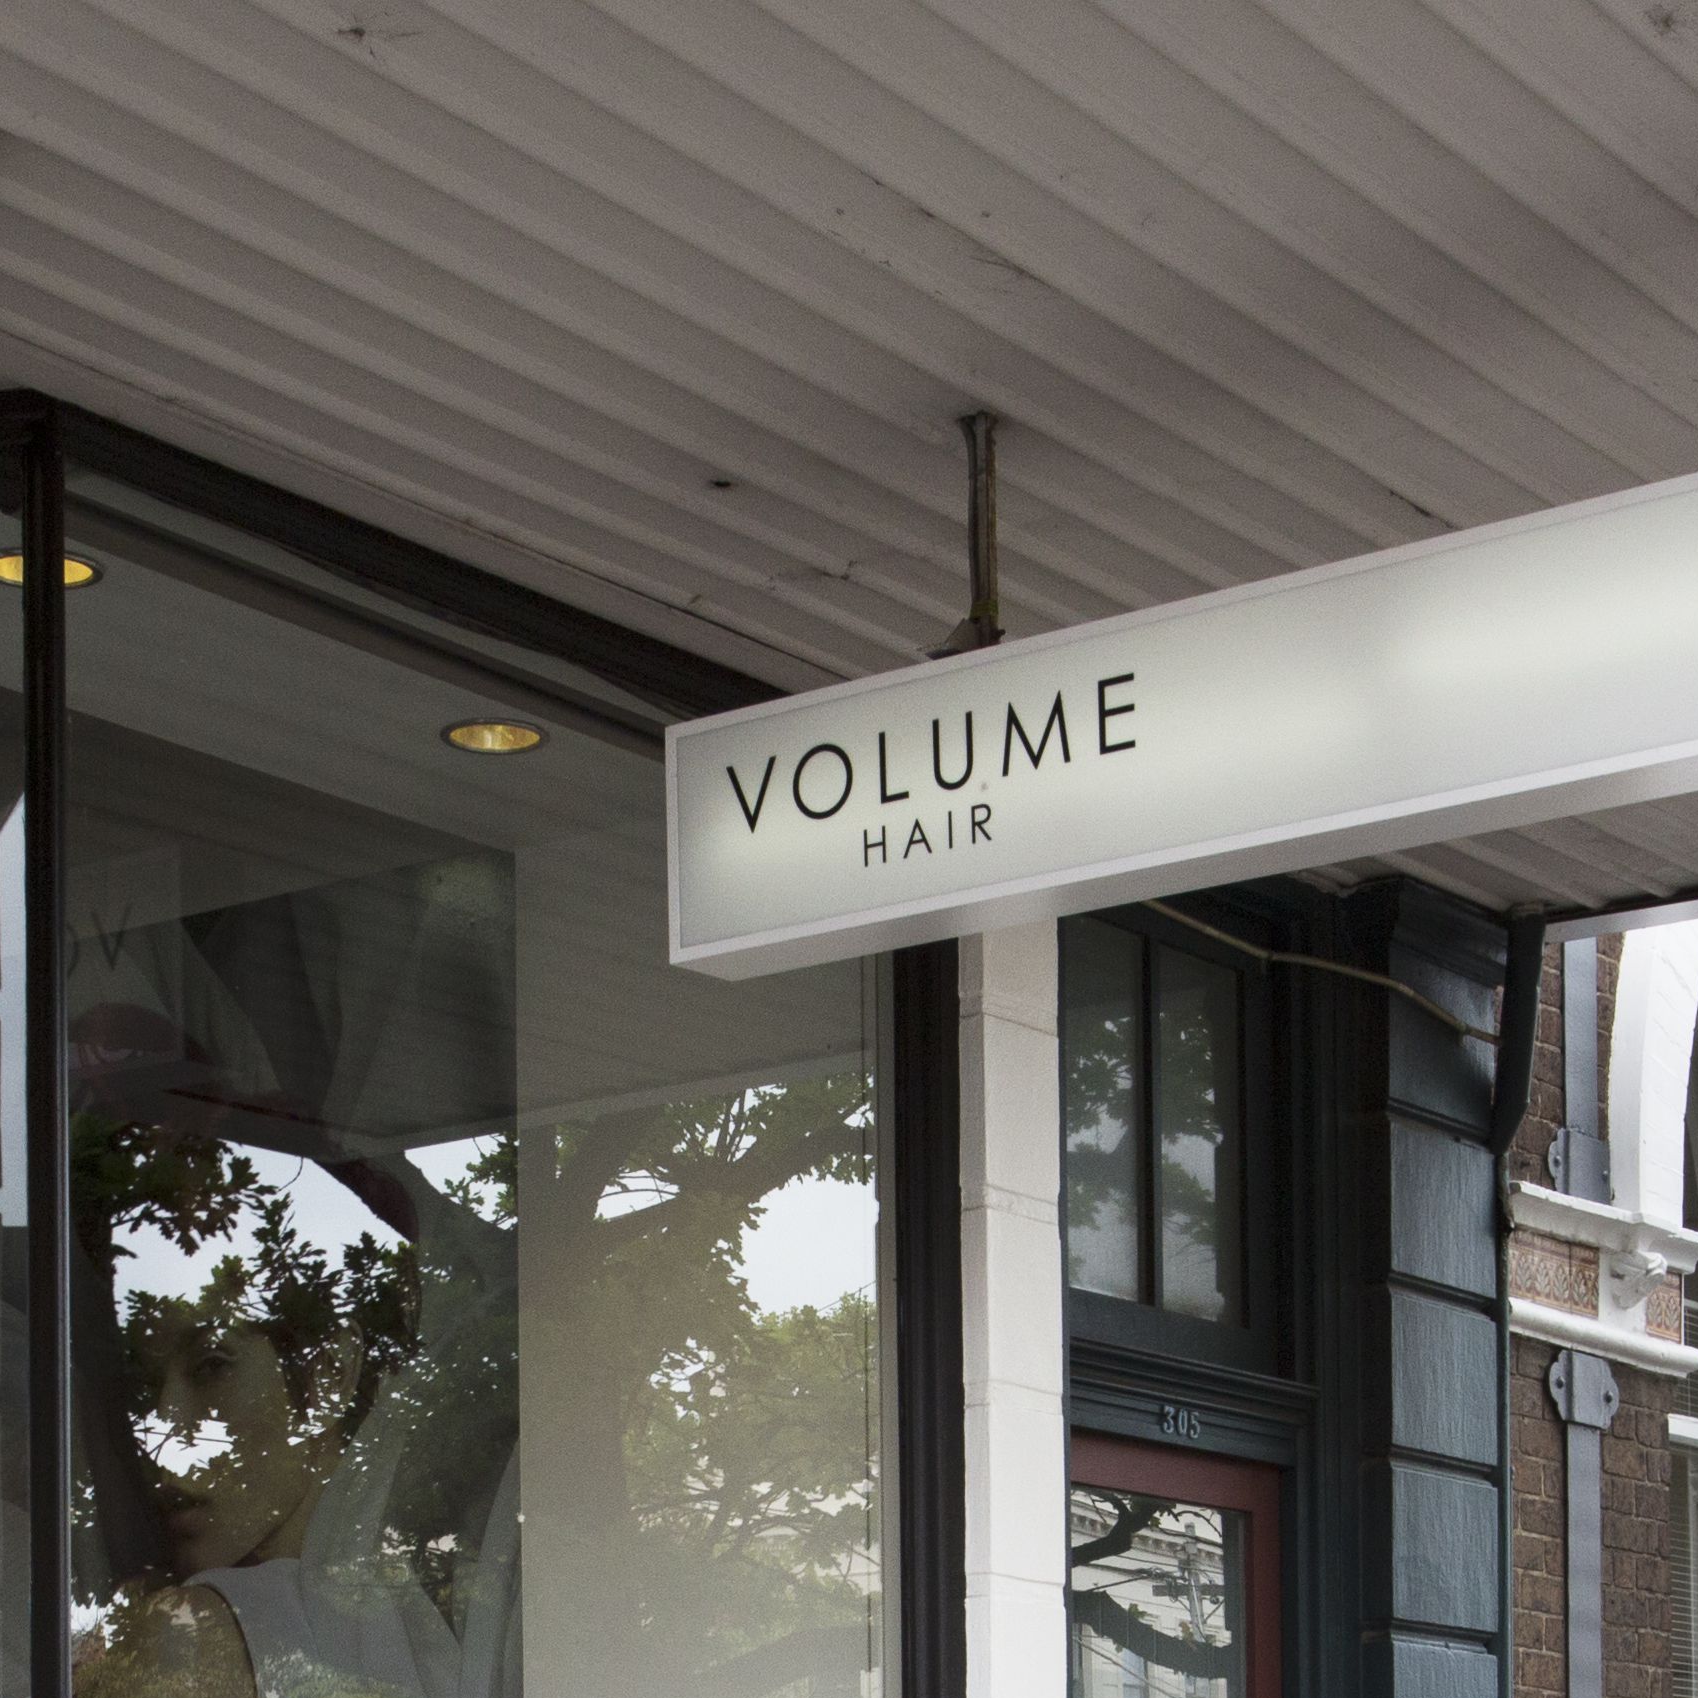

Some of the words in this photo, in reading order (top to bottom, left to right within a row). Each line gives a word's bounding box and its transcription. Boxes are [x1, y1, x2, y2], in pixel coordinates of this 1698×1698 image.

[726, 672, 1137, 834] VOLUME
[863, 803, 993, 867] HAIR
[1161, 1404, 1201, 1439] 305
